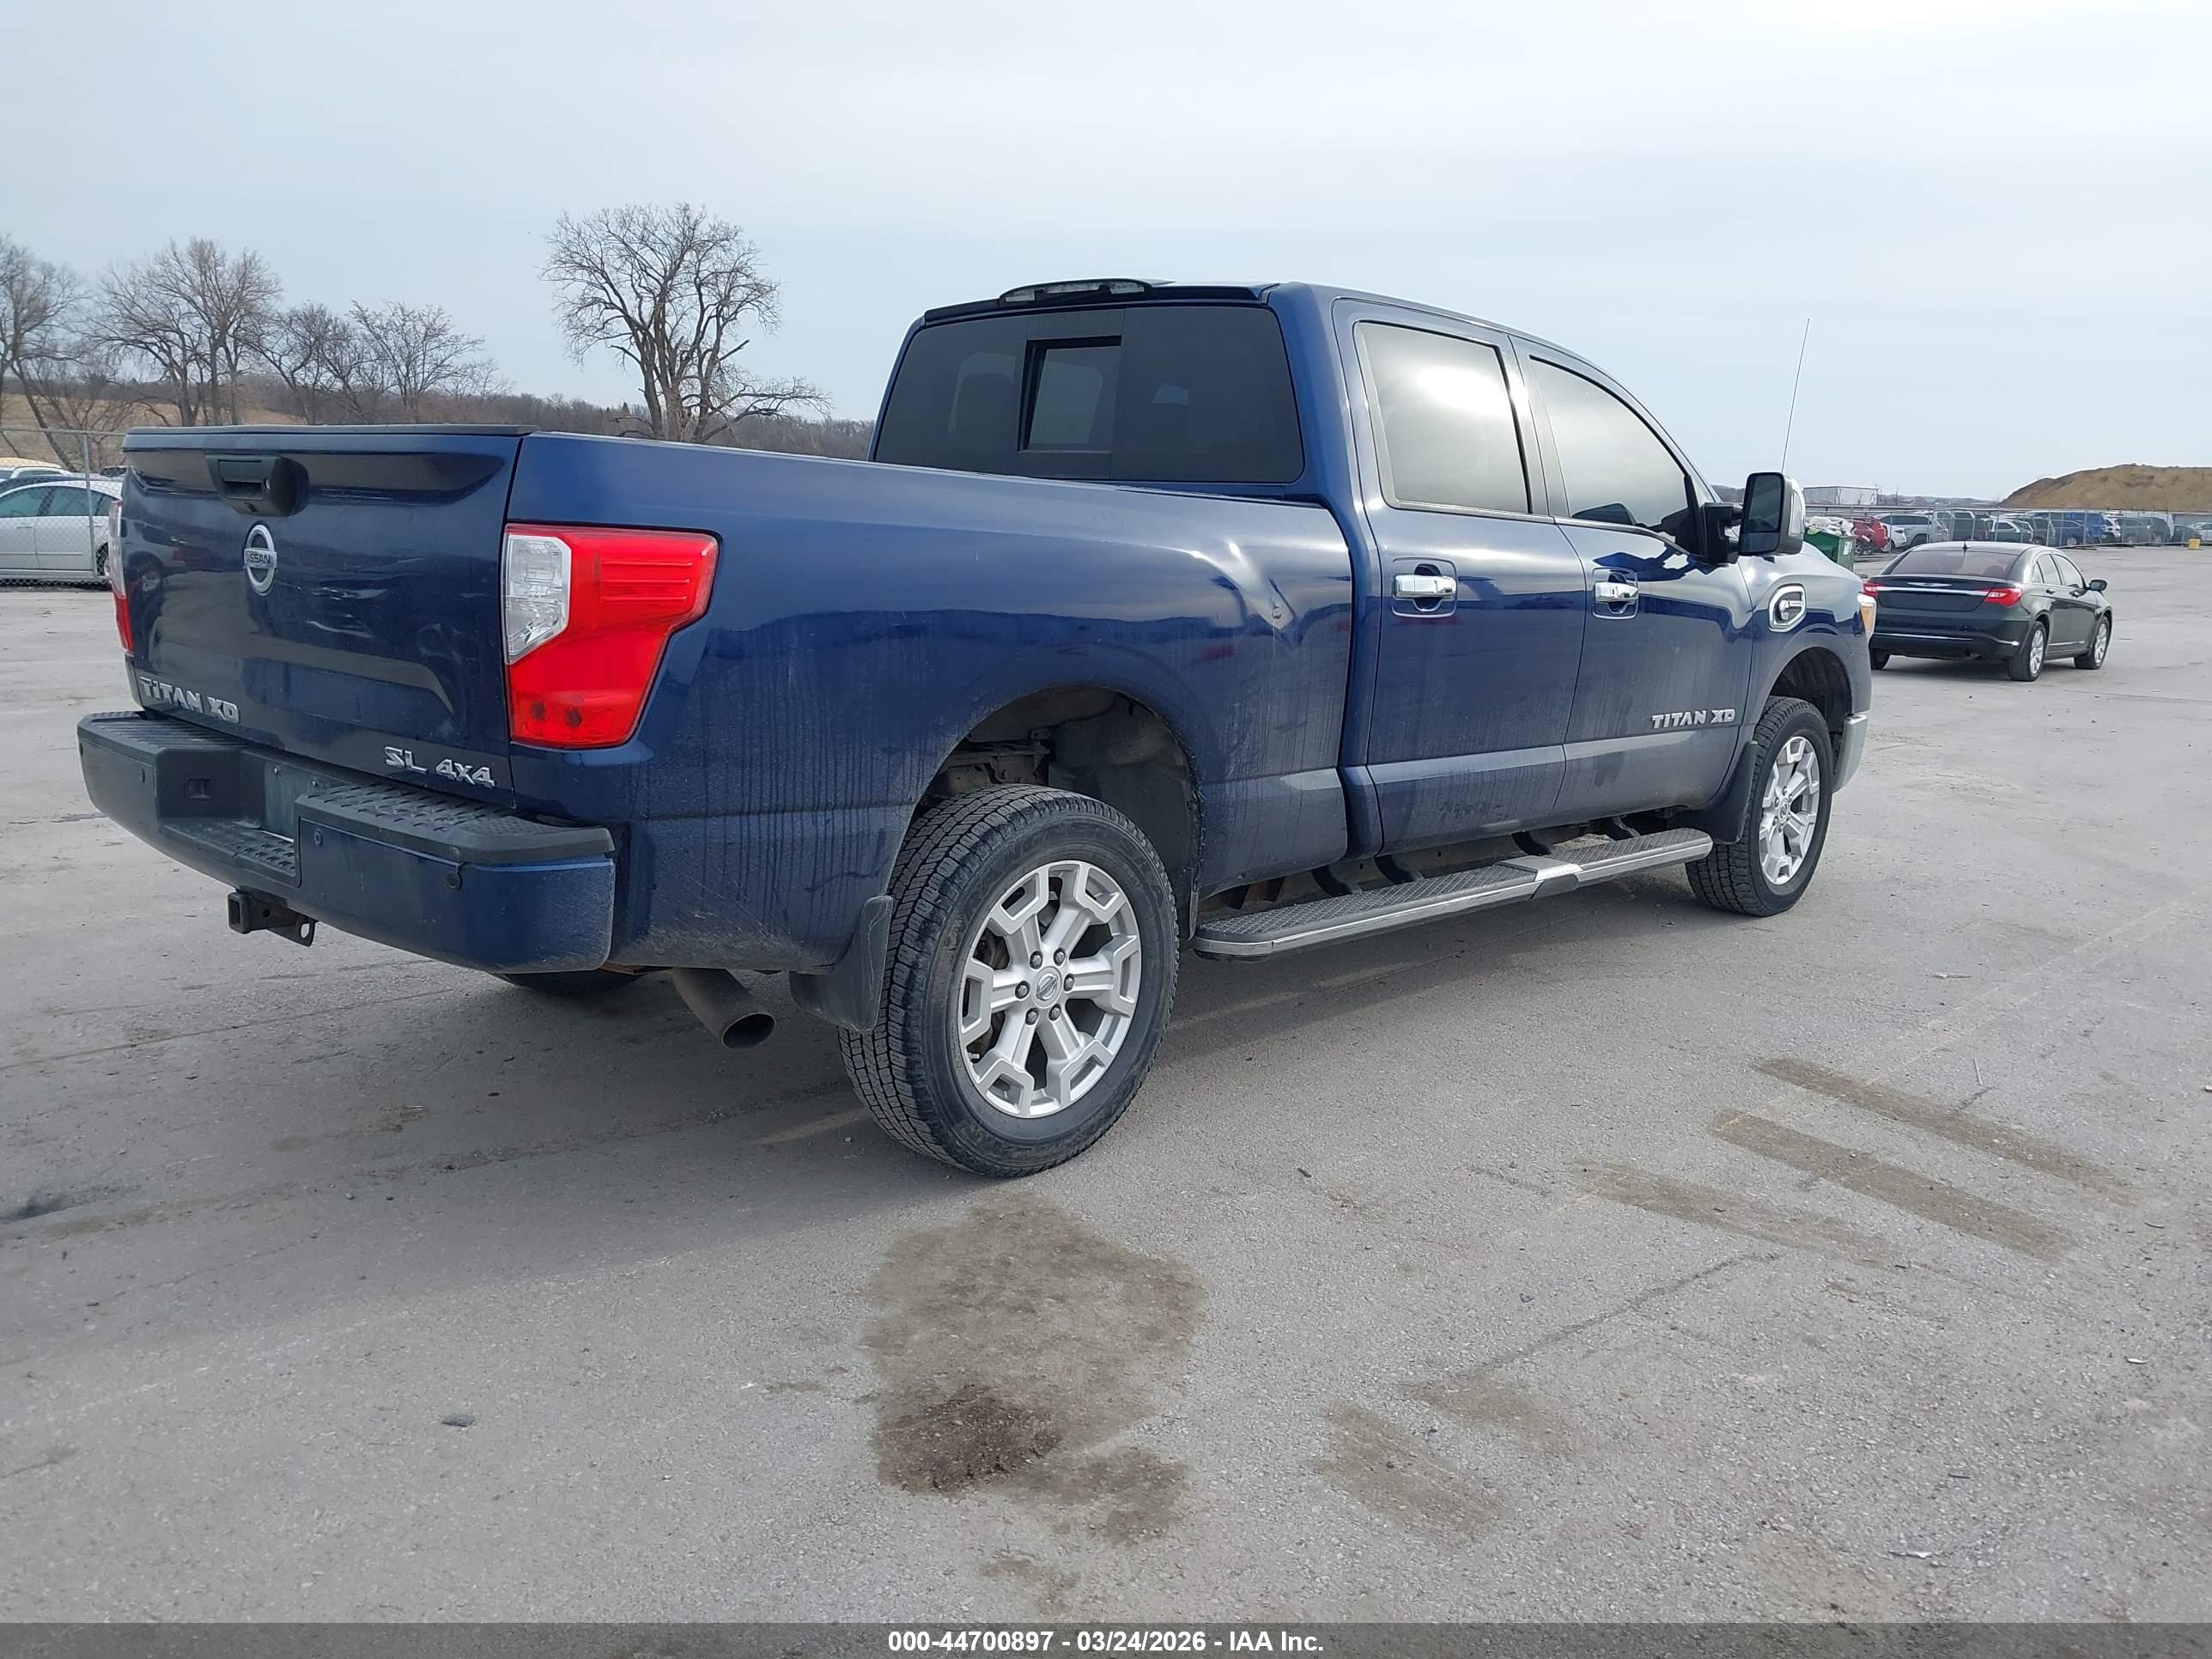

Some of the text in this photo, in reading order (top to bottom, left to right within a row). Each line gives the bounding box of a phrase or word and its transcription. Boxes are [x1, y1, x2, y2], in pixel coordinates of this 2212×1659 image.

[139, 676, 240, 723] TITAN XD
[1651, 708, 1735, 729] TITAN XD
[384, 746, 428, 775] SL
